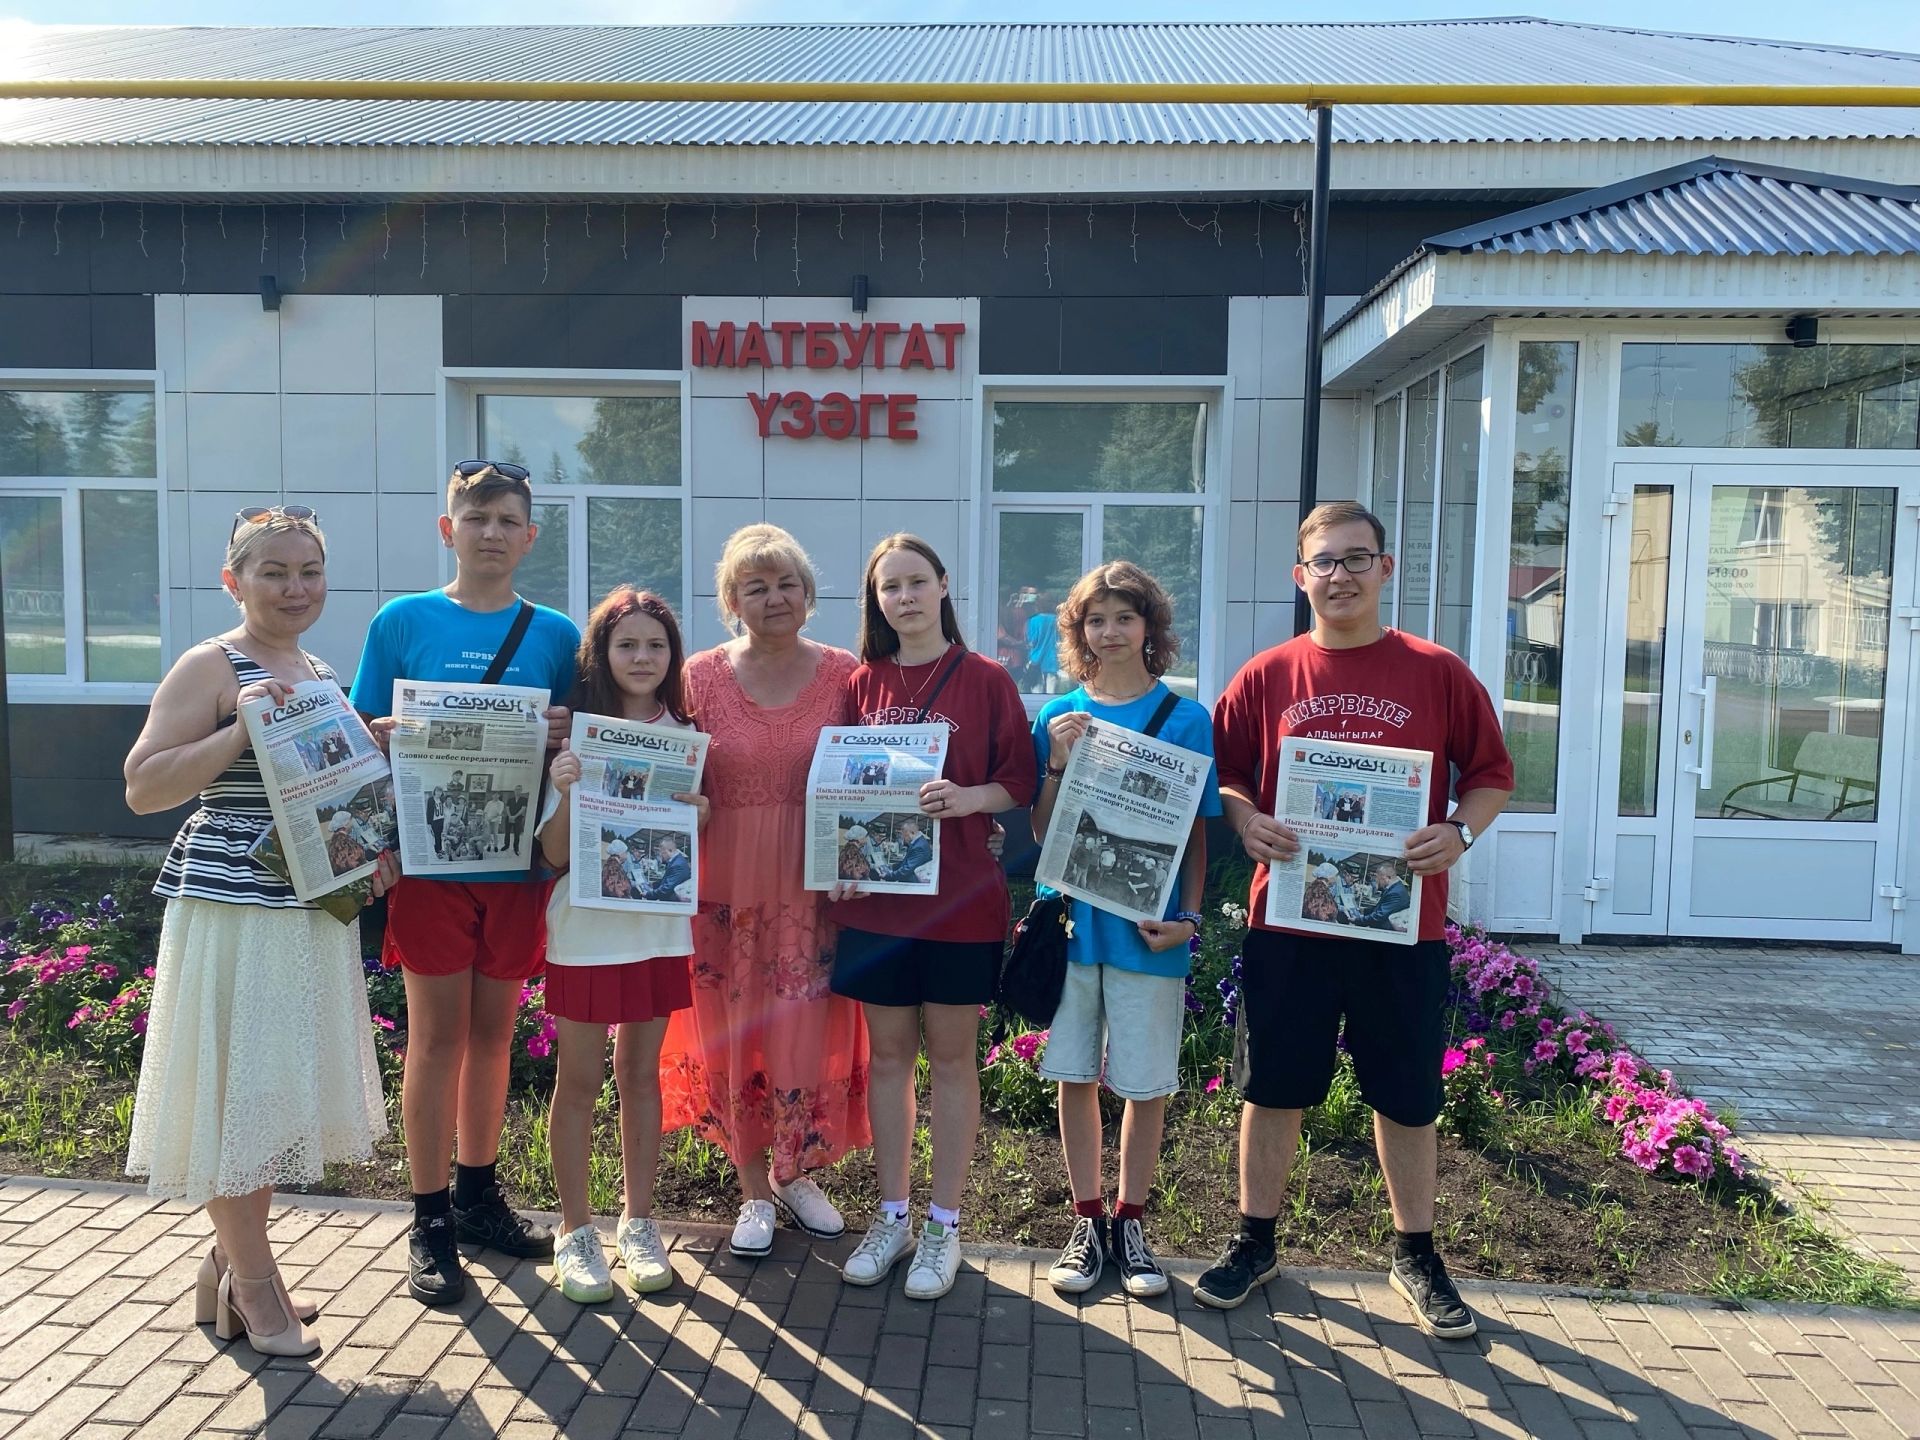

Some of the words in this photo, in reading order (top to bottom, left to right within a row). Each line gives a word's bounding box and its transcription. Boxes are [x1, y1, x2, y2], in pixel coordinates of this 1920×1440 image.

[692, 321, 966, 369] МАТБУГАТ
[746, 391, 919, 440] ҮЗӘГЕ
[461, 651, 497, 661] ПЕРВЫ
[1281, 694, 1412, 728] ПЕРВЫЕ
[1306, 730, 1384, 739] АЛДЫНГЫЛАР
[398, 752, 428, 760] Словно
[435, 753, 459, 761] небес
[1117, 792, 1130, 803] без
[1130, 798, 1151, 810] хлеба
